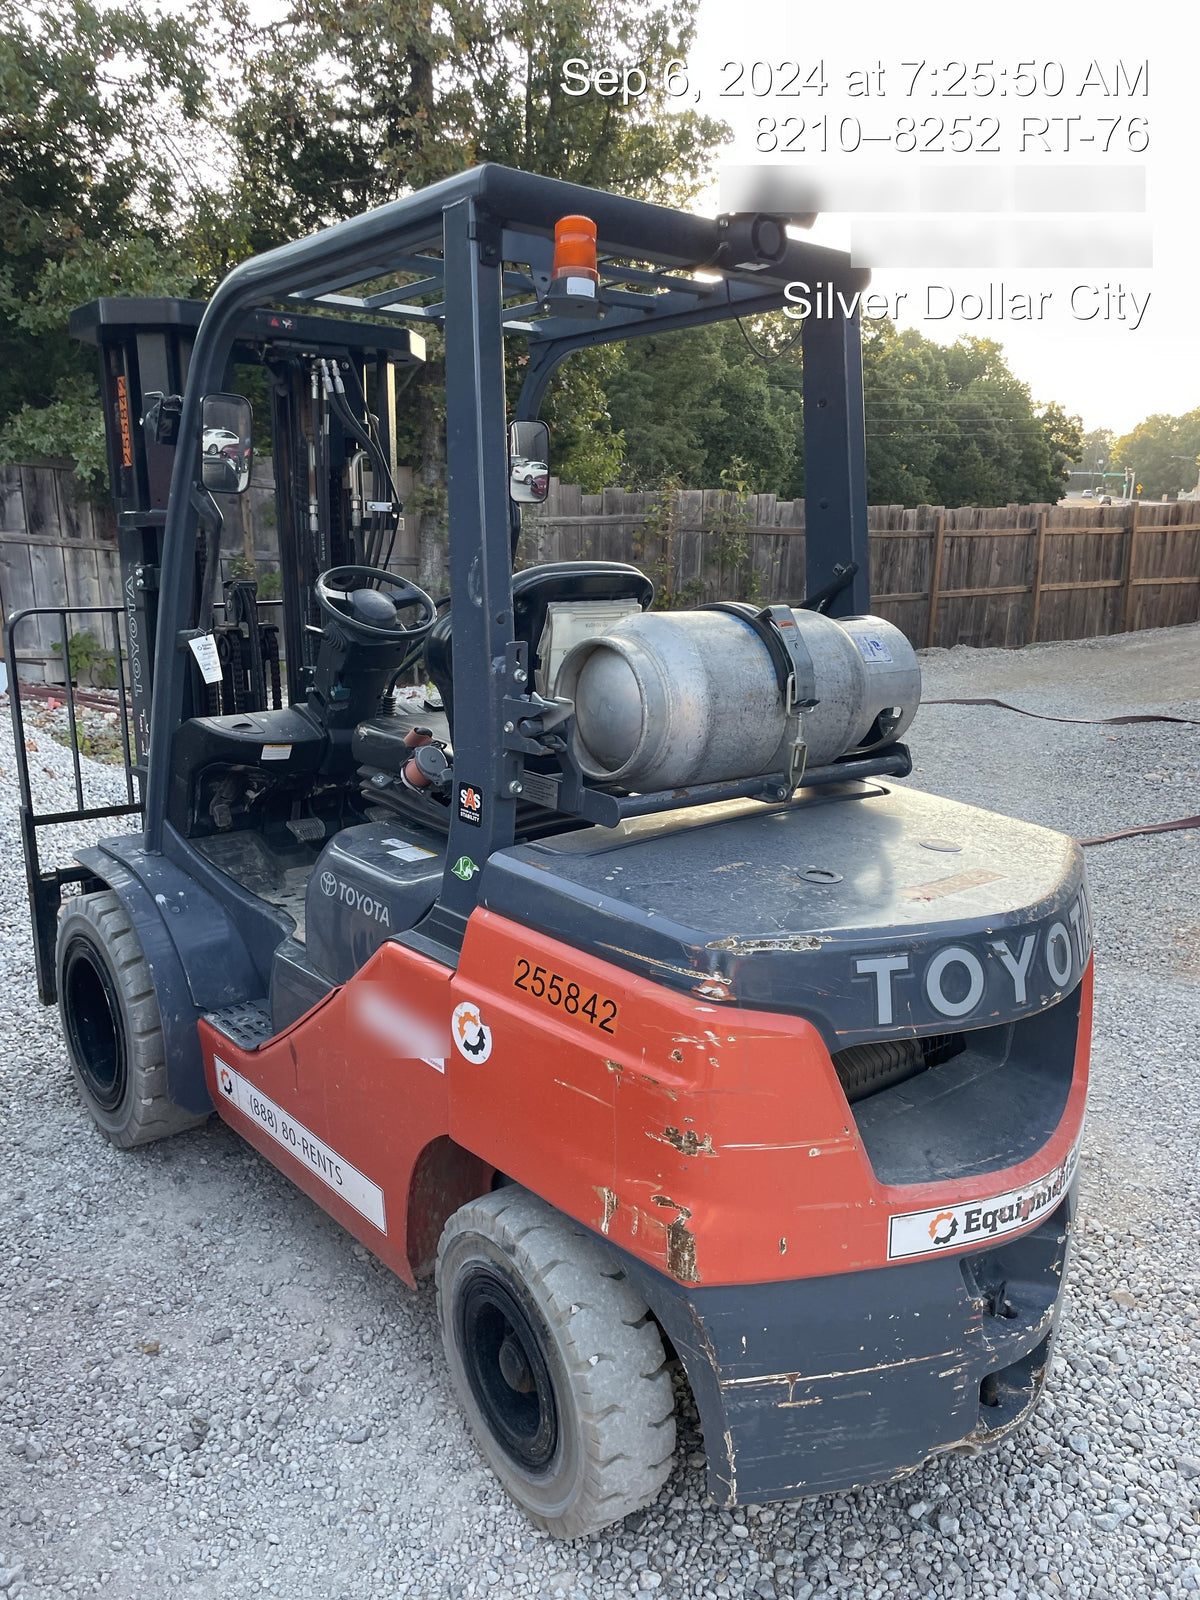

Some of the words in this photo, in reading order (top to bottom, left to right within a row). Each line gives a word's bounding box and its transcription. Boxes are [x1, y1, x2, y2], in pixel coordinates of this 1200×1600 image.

[126, 575, 143, 697] TOYOTA
[460, 788, 481, 811] SAS
[340, 881, 390, 928] TOYOTA
[514, 959, 617, 1034] 255842
[249, 1094, 278, 1133] (888)
[281, 1121, 343, 1186] 80-RENTS
